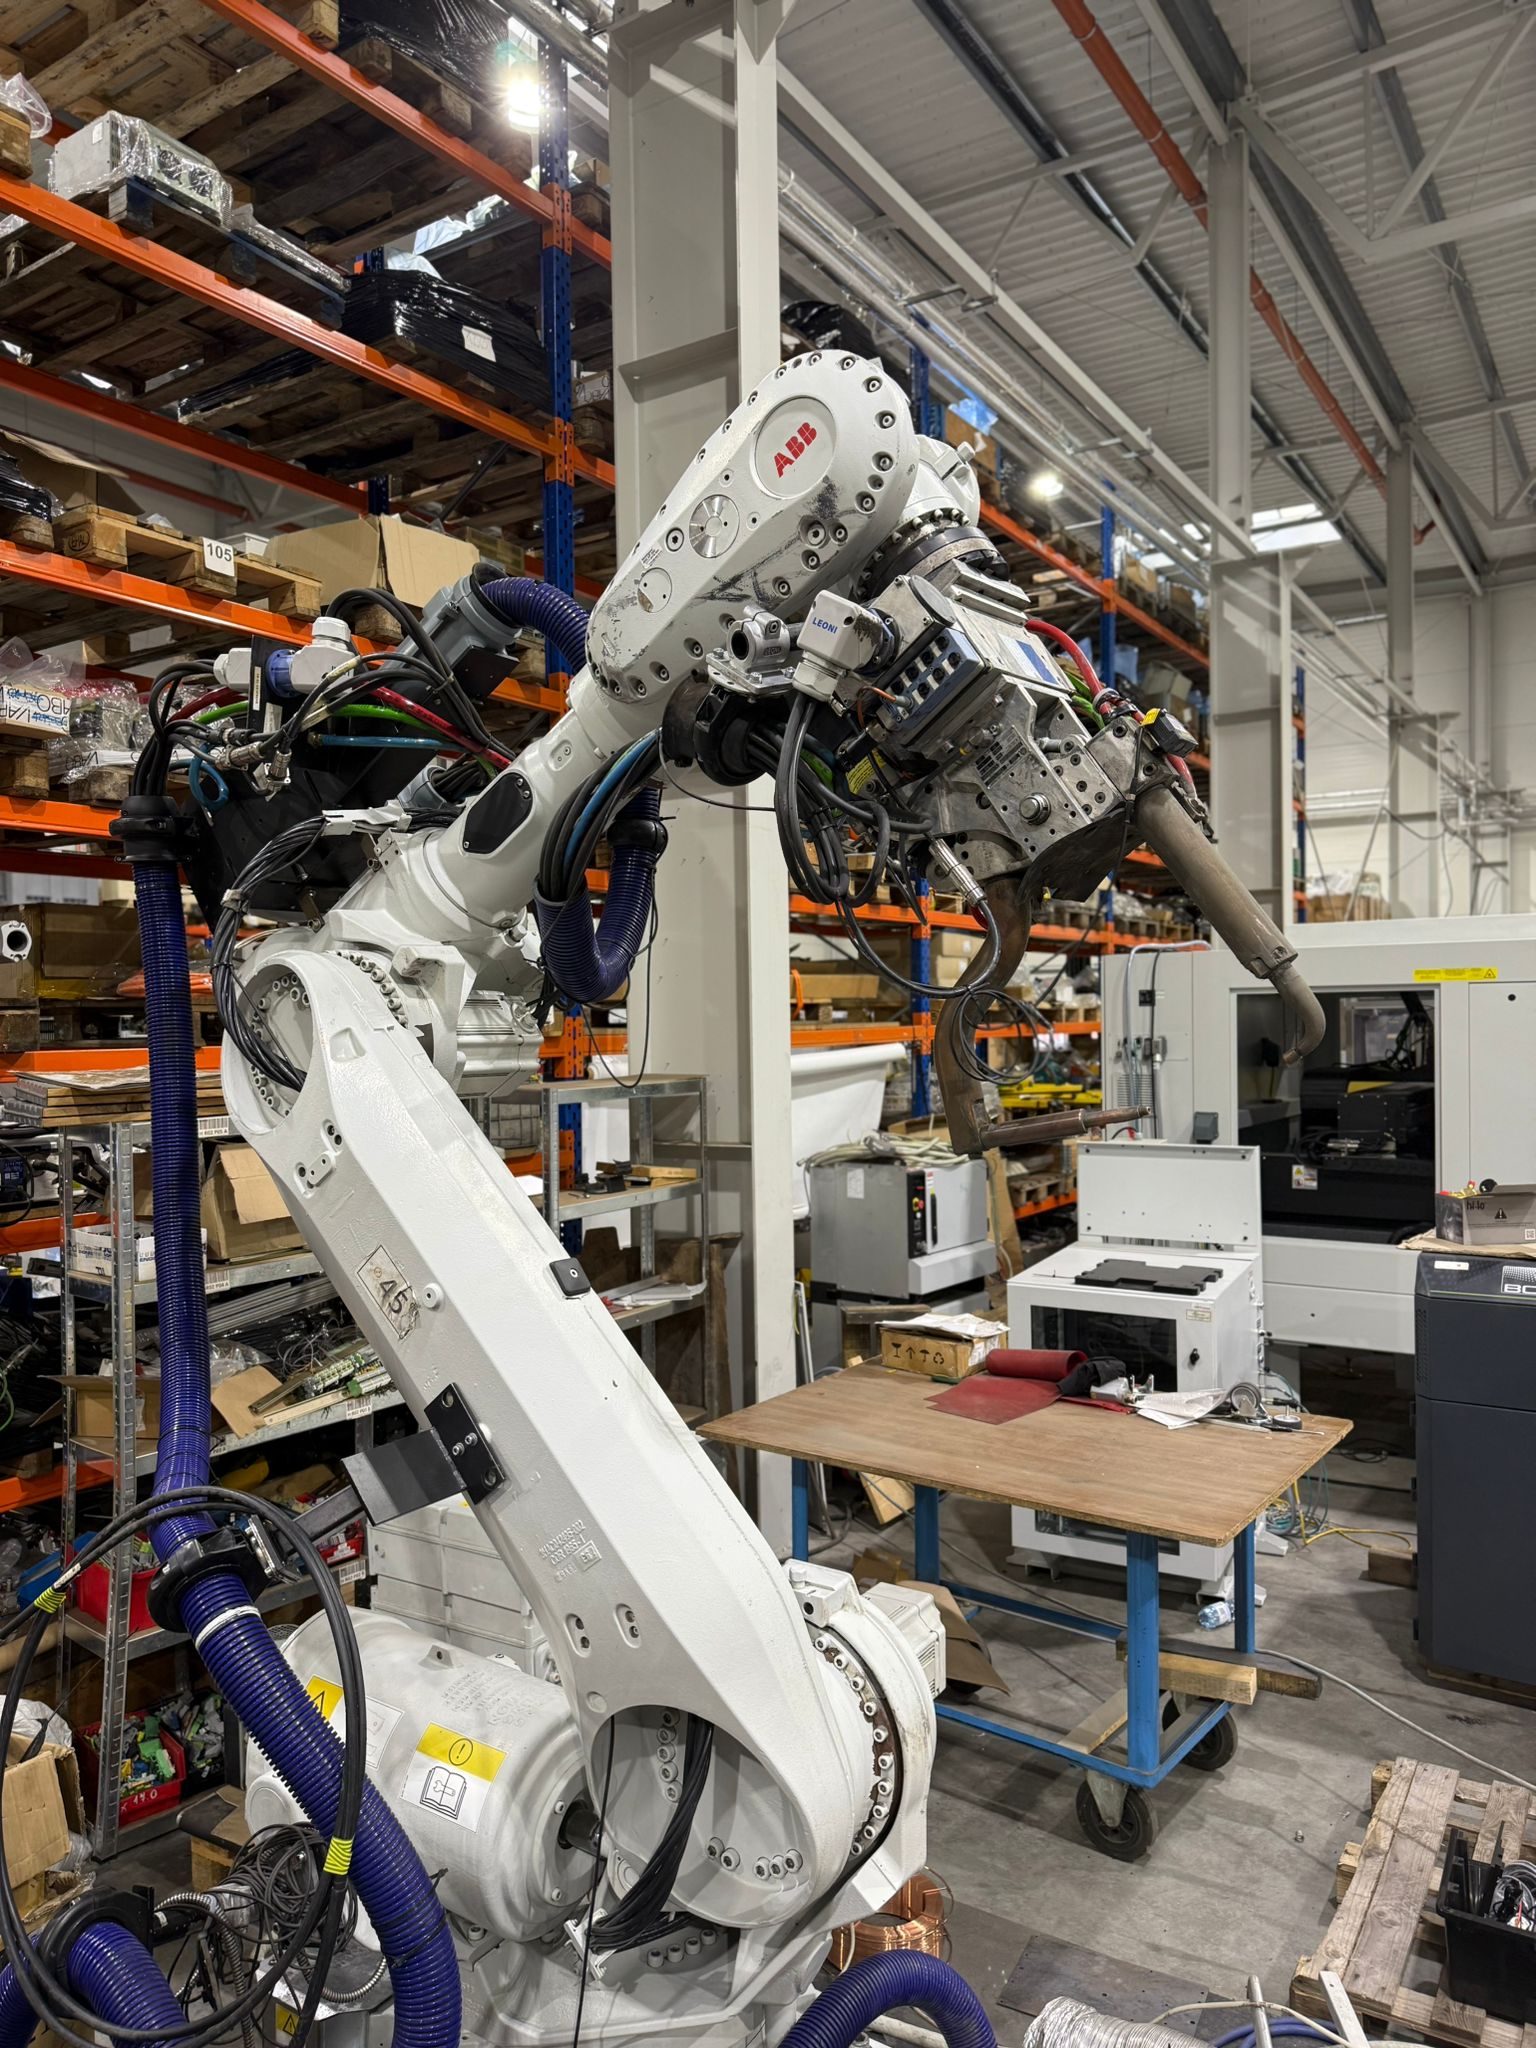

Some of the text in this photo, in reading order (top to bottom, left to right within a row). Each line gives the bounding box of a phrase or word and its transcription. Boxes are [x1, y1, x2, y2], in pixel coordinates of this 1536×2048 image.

[774, 422, 817, 478] ABB
[206, 543, 232, 562] 105
[812, 617, 838, 634] LEONI
[1466, 1200, 1485, 1211] hi-lo
[380, 1280, 408, 1313] 45
